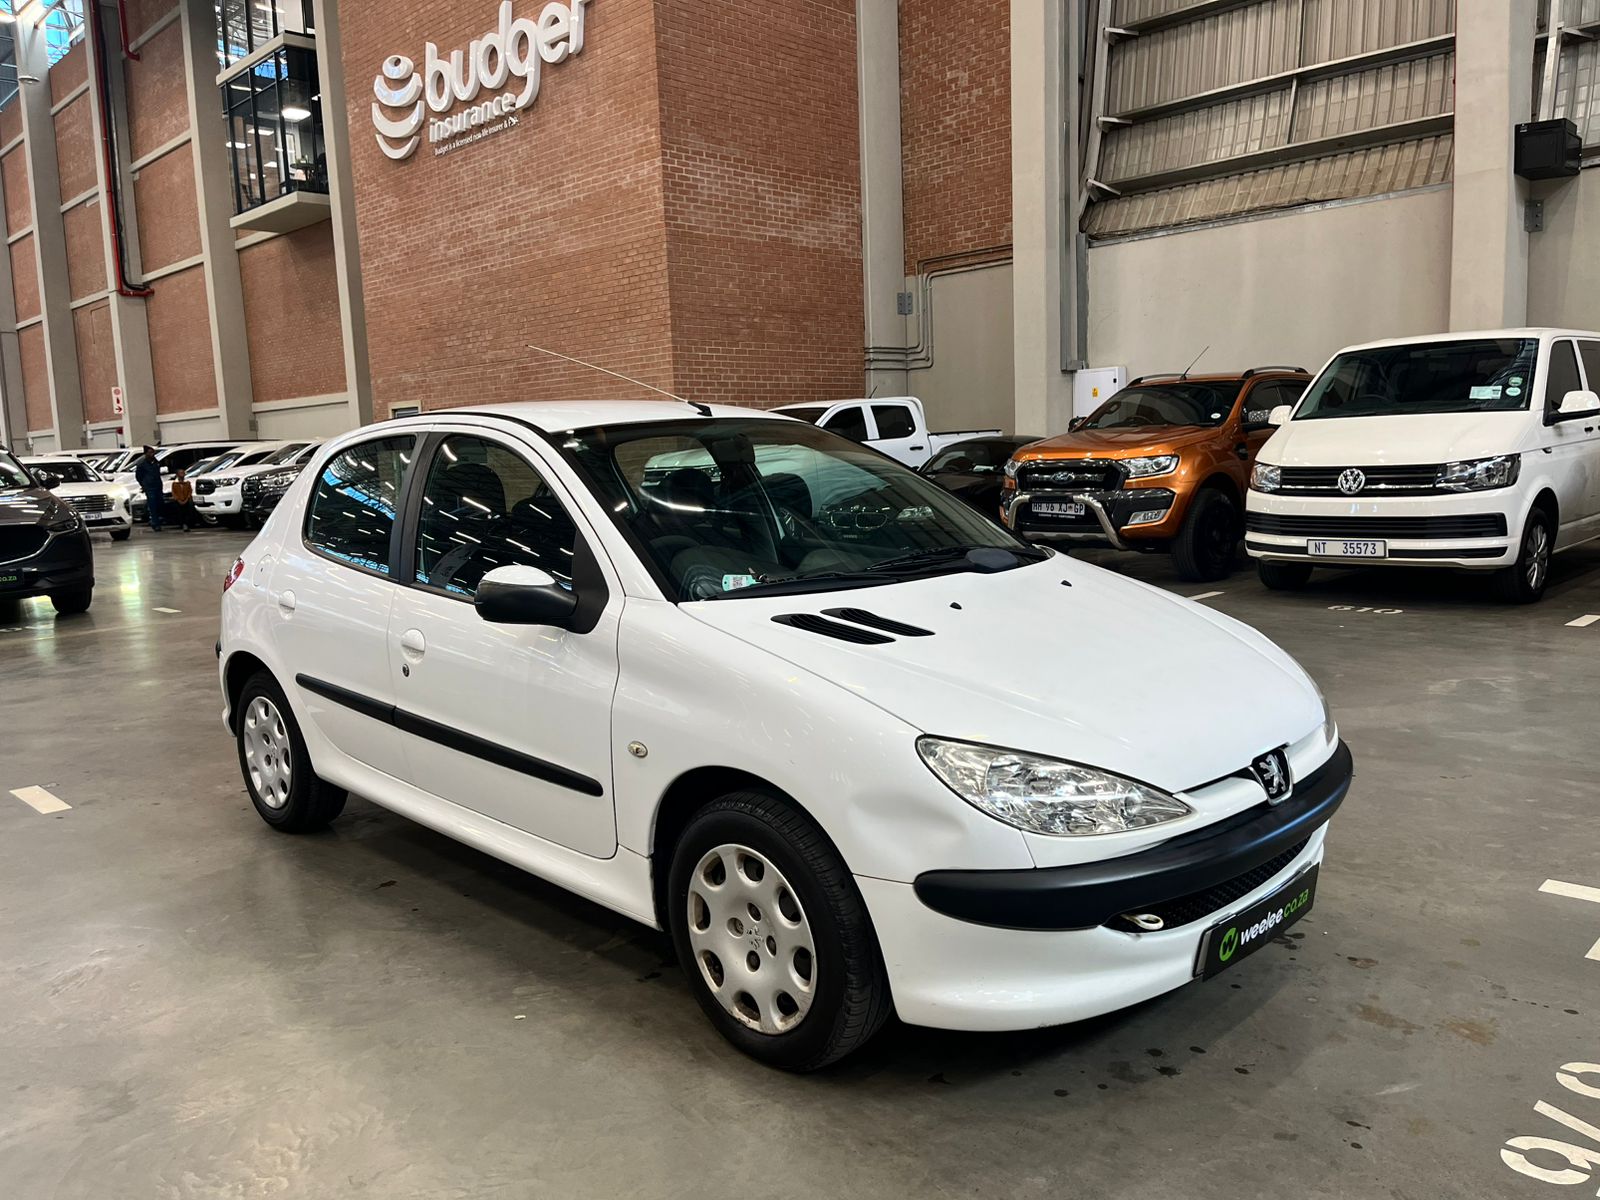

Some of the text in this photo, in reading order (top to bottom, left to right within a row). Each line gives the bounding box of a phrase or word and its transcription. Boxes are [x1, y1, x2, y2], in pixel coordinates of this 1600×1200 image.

[429, 92, 516, 143] insurance
[1315, 542, 1377, 555] NT 35573
